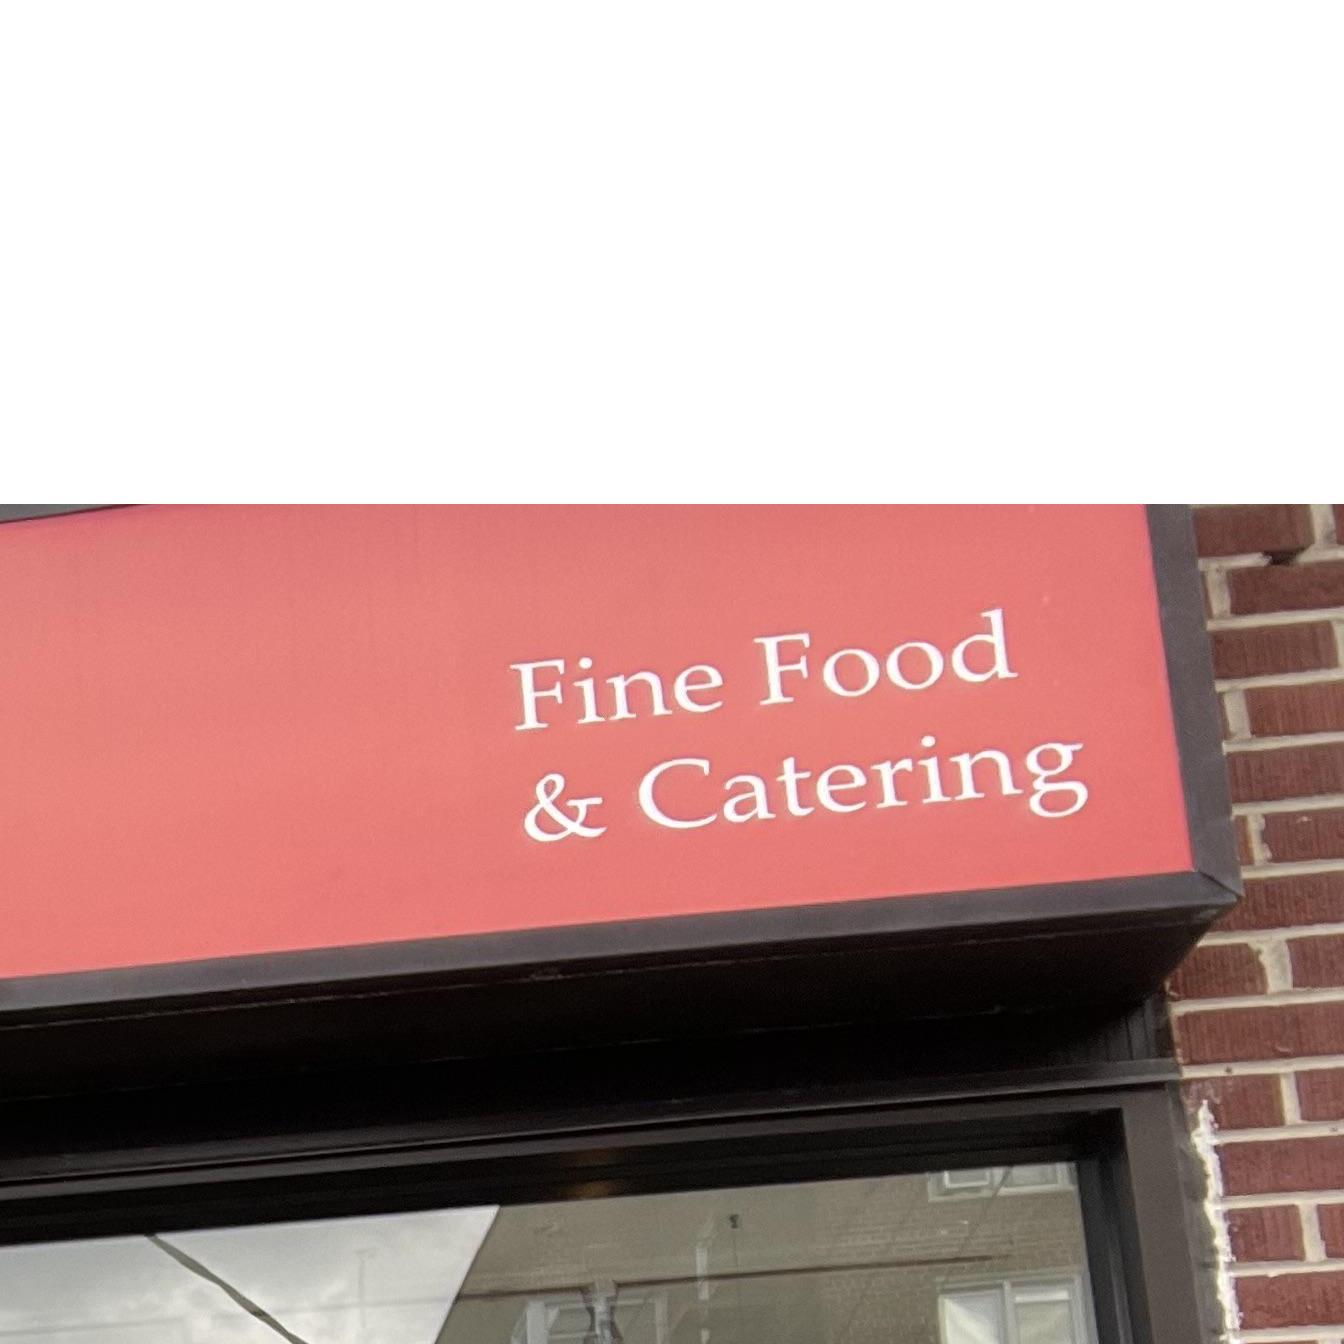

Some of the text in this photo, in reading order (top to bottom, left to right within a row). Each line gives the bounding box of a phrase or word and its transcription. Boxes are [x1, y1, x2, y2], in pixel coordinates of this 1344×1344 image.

[511, 609, 1017, 730] Fine Food
[525, 736, 1087, 841] & Catering
